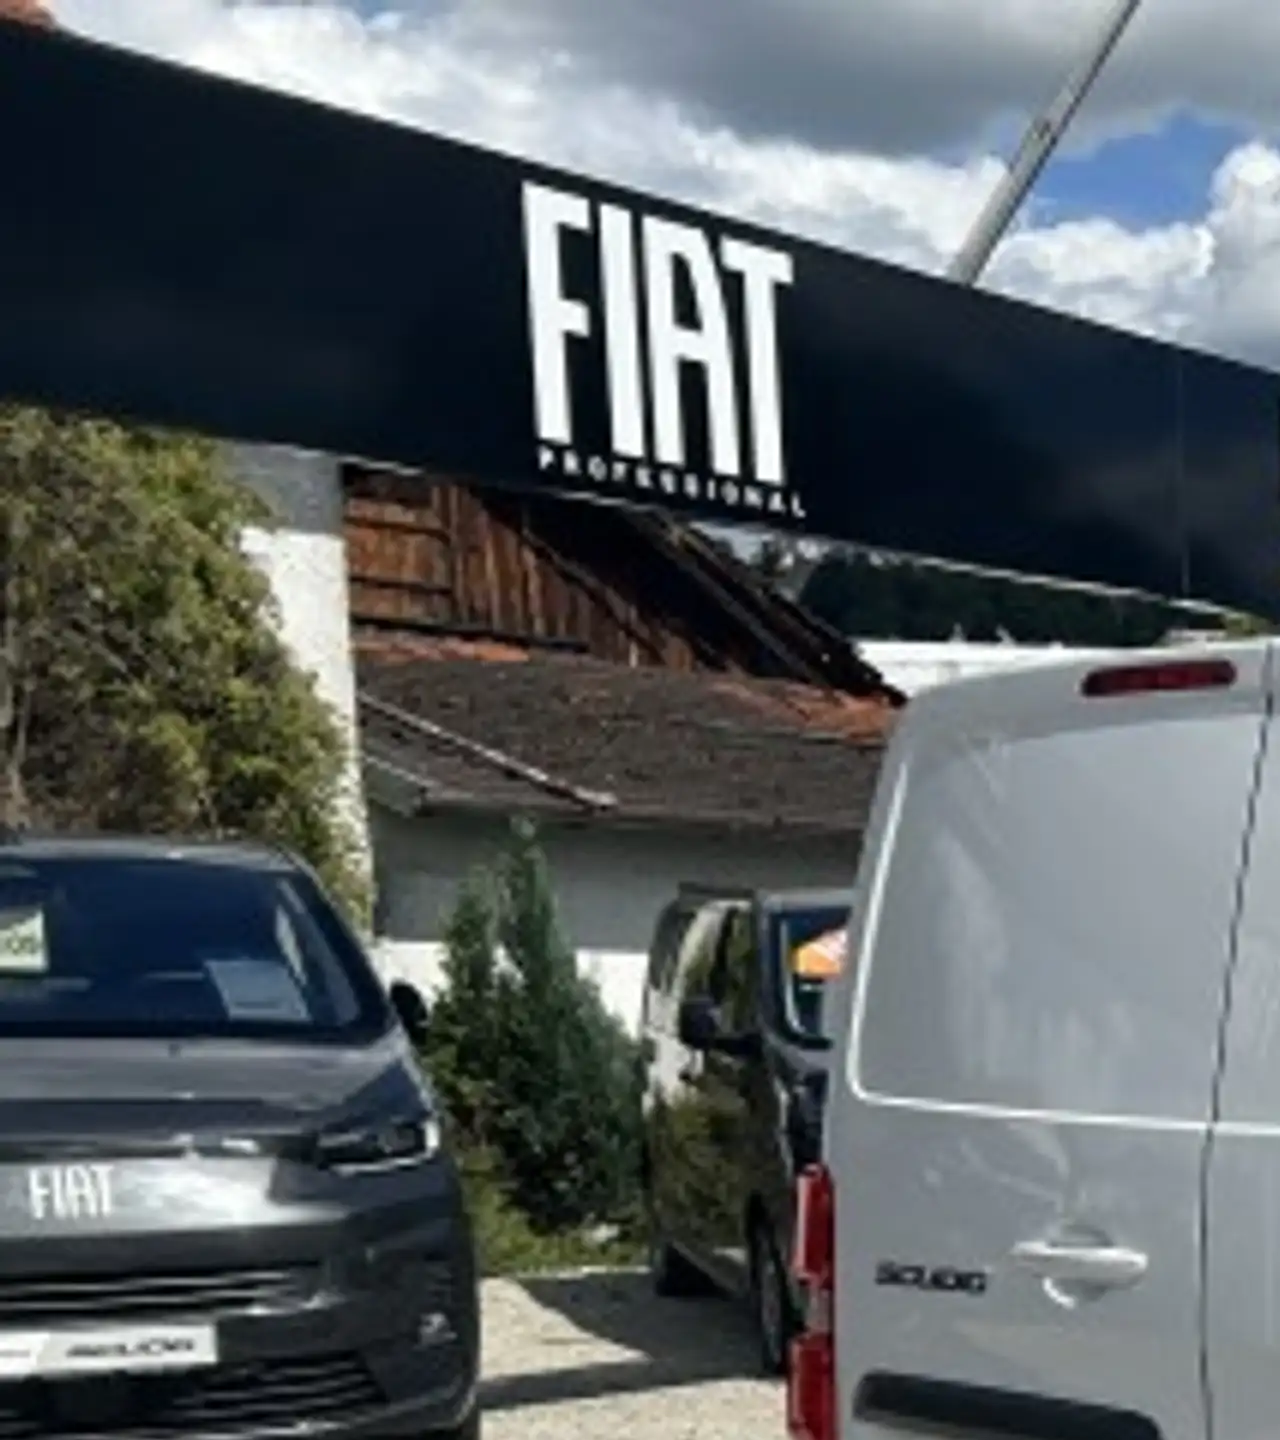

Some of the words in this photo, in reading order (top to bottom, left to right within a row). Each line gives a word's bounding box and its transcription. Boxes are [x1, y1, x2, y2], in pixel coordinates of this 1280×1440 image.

[521, 180, 794, 486] FIAT
[536, 444, 806, 519] PROFESSIONAL
[28, 1164, 114, 1220] FIAT
